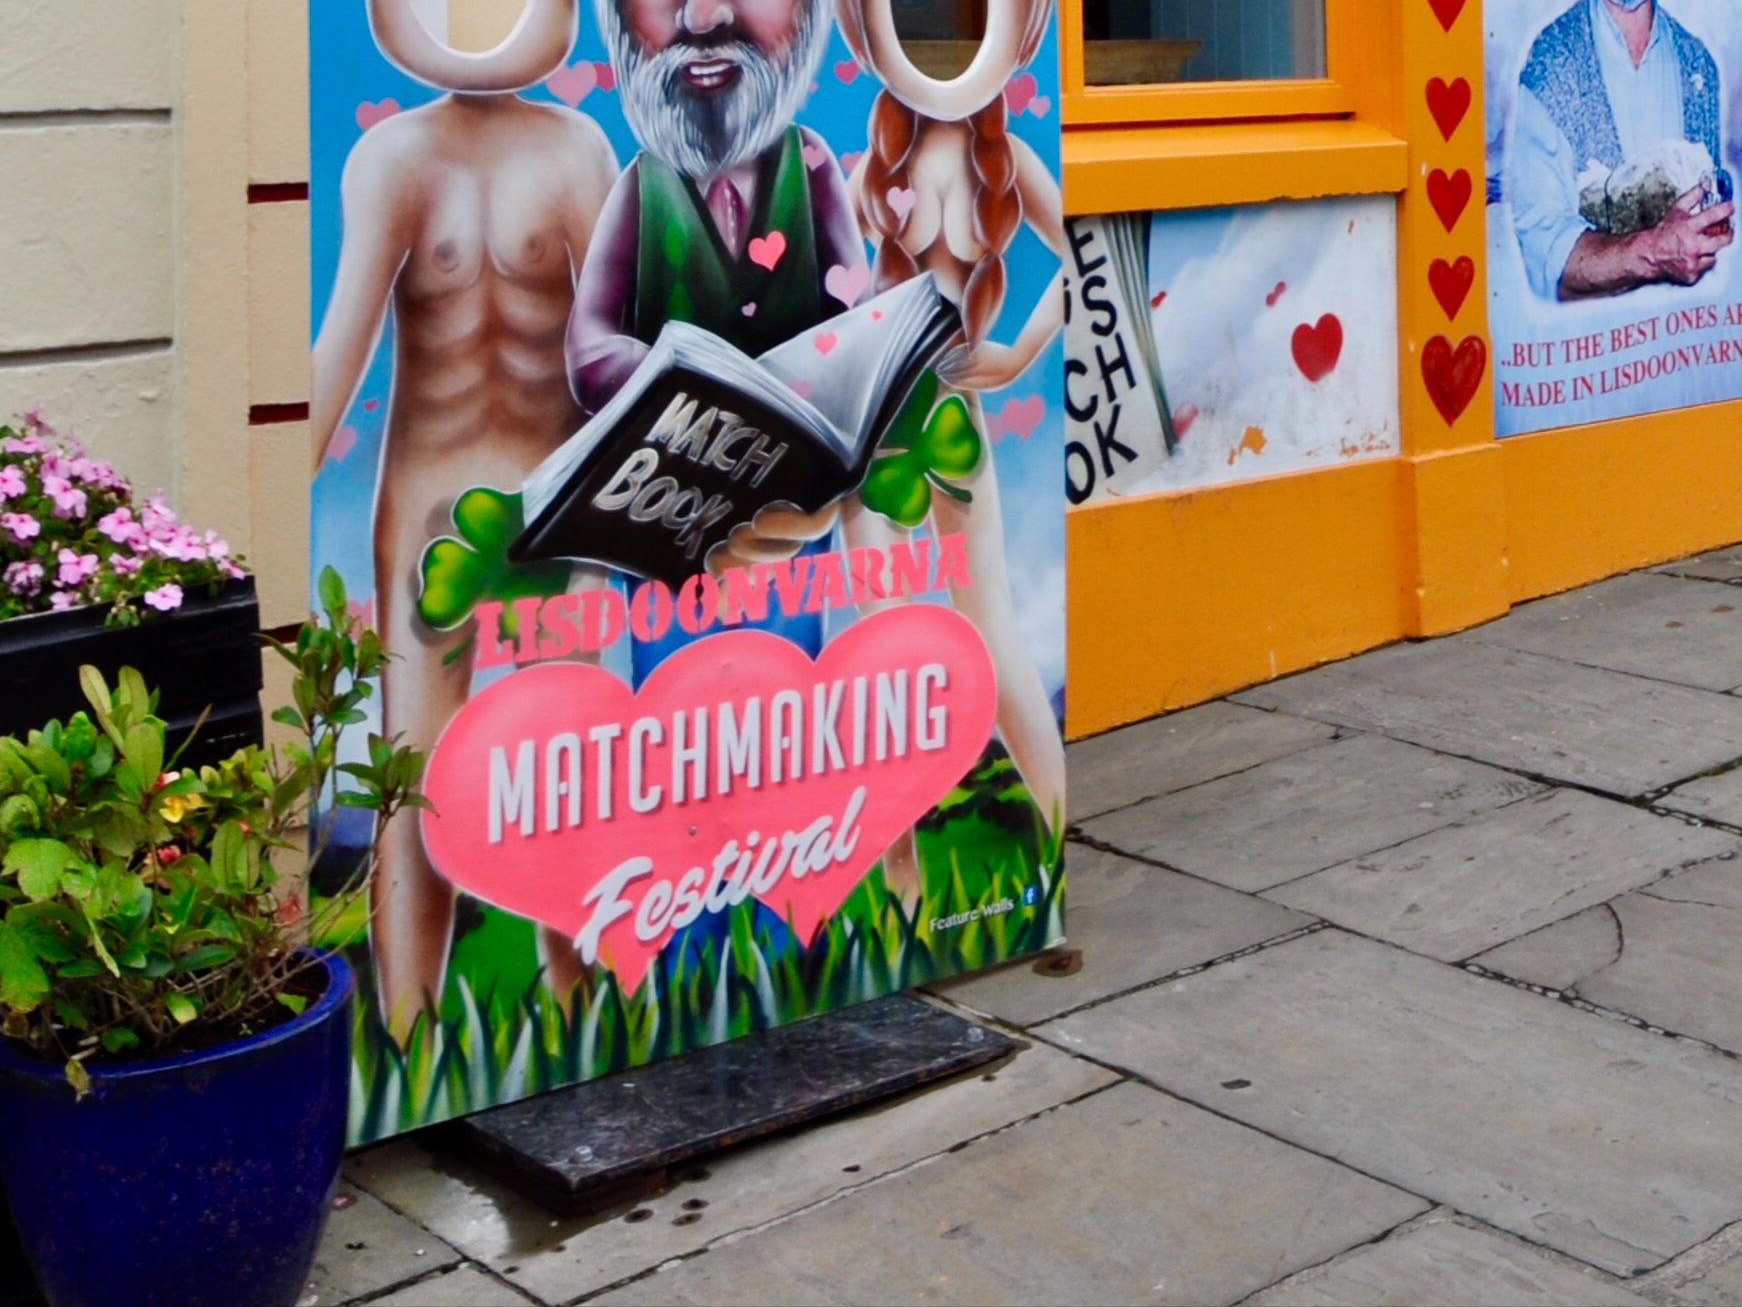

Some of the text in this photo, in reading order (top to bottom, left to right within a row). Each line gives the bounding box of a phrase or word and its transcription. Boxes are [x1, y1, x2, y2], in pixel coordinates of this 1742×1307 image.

[1560, 333, 1604, 364] THE
[1610, 317, 1660, 353] BEST
[1666, 304, 1718, 336] ONES
[645, 392, 789, 488] MATCH
[1501, 380, 1566, 407] MADE
[1572, 374, 1594, 401] IN
[592, 447, 733, 559] BOOK
[474, 532, 973, 670] LISDOONVARNA
[488, 663, 949, 844] MATCHMAKING
[573, 786, 867, 965] Festival
[930, 910, 980, 933] Feature
[981, 896, 1015, 919] Walls
